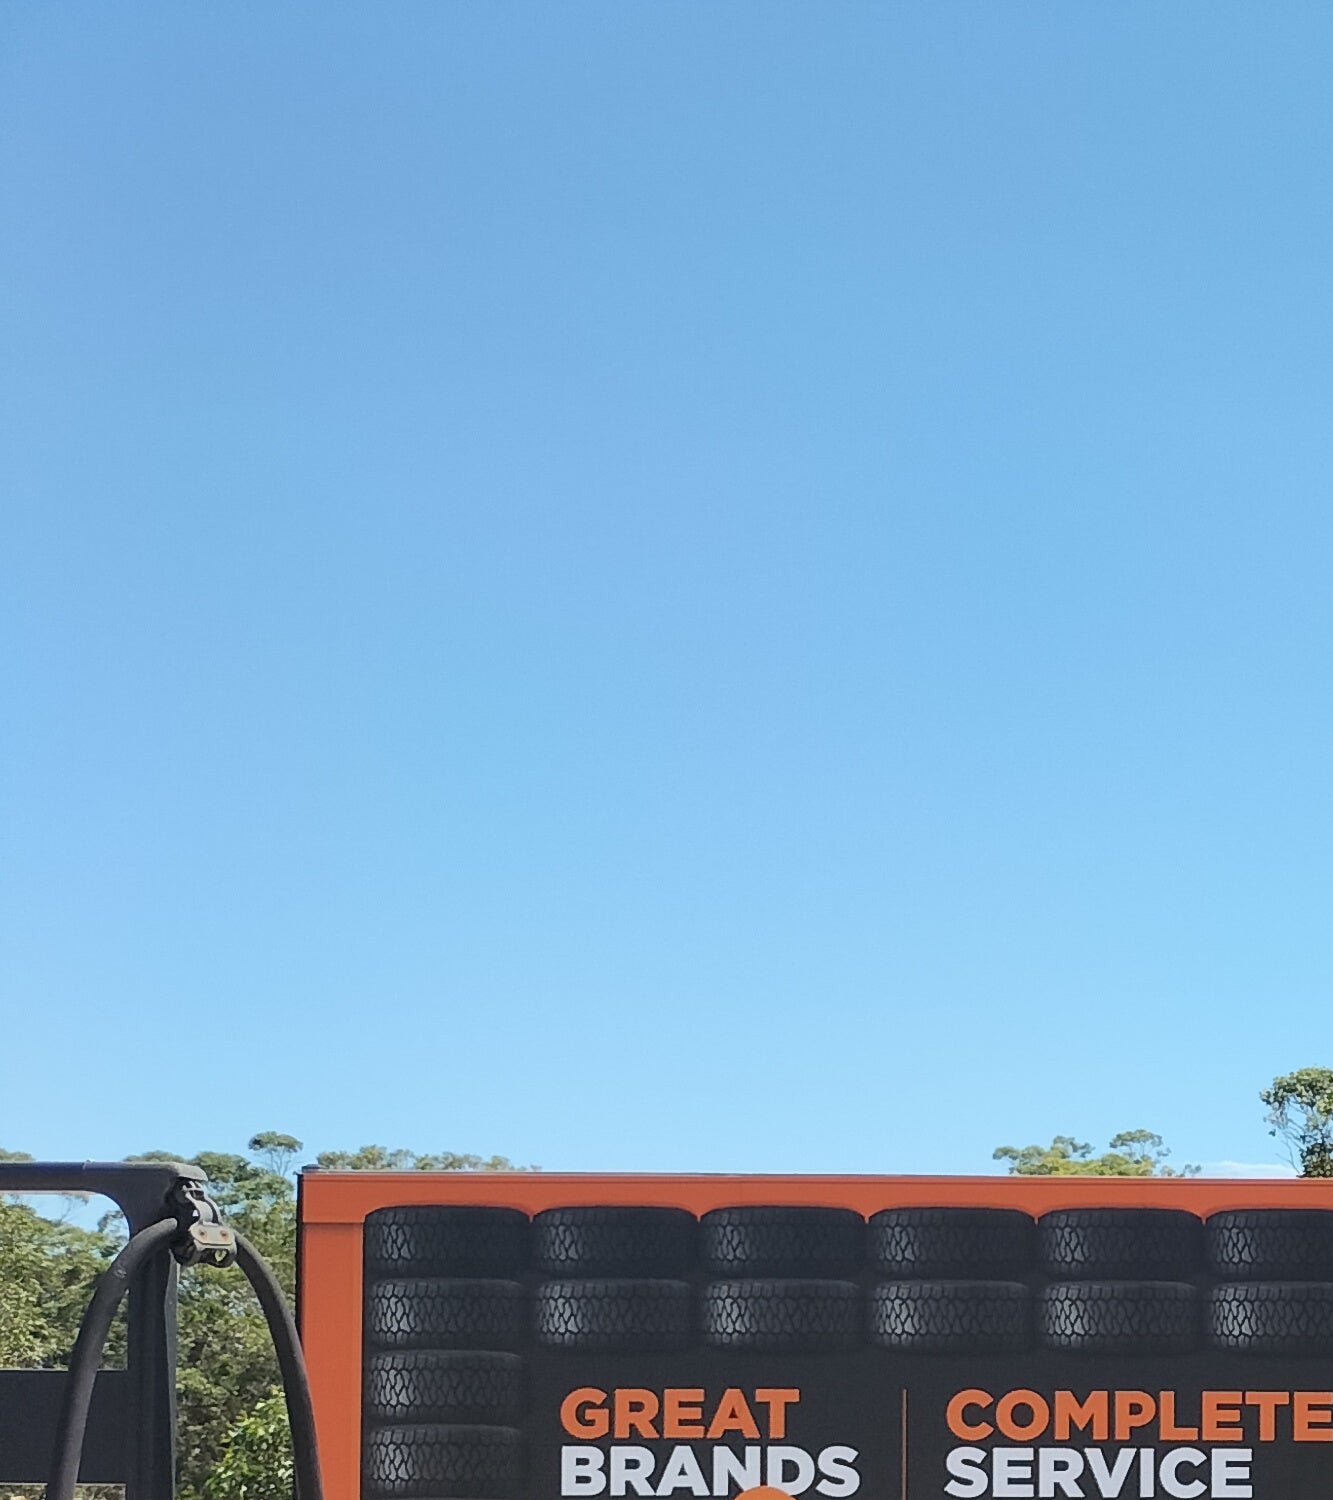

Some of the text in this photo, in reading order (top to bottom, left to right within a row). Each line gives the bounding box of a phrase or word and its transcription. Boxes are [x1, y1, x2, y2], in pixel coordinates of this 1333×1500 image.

[560, 1388, 800, 1440] GREAT
[560, 1445, 861, 1498] BRANDS
[944, 1447, 1254, 1500] SERVICE
